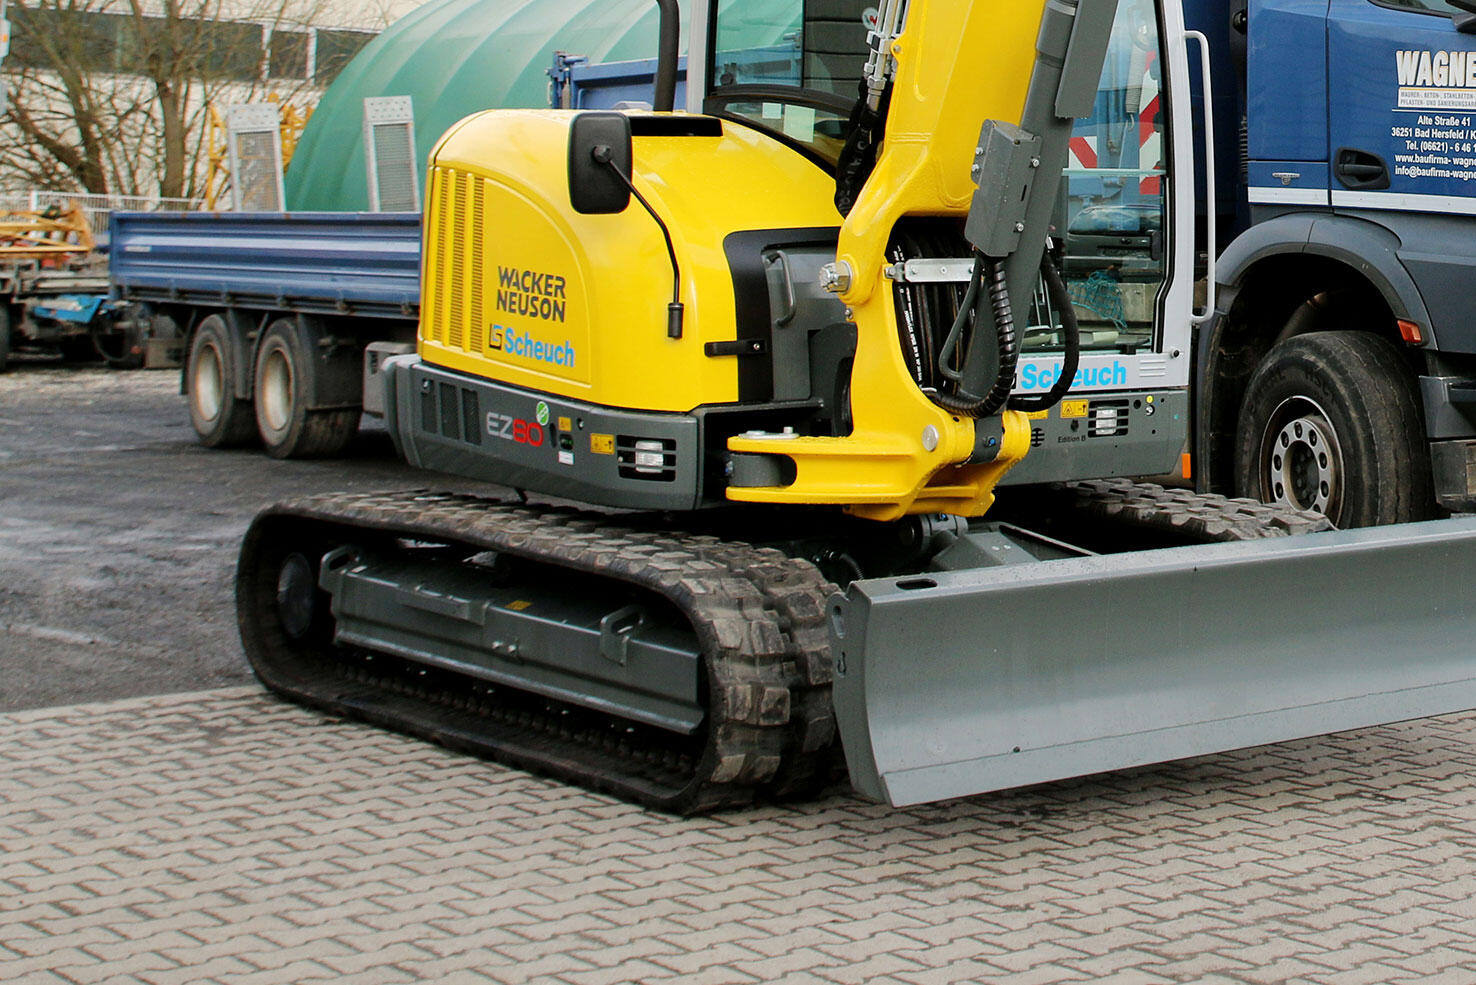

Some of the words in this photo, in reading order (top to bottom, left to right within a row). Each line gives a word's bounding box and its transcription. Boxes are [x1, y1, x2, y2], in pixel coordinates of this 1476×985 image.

[1417, 115, 1433, 126] Alte
[1434, 116, 1460, 127] Straße
[1461, 116, 1471, 127] 41
[1391, 127, 1413, 137] 36251
[1414, 128, 1430, 138] Bad
[1431, 128, 1464, 140] Hersfeld
[1405, 140, 1419, 150] Tel.
[1420, 141, 1448, 153] (06621)
[1454, 143, 1460, 152] 6
[1461, 143, 1471, 152] 46
[1395, 154, 1451, 165] www.baufirma-
[498, 266, 566, 299] WACKER
[496, 289, 566, 323] NEUSON
[504, 327, 575, 368] Scheuch
[486, 411, 544, 448] EZ80
[1057, 436, 1080, 444] Edition
